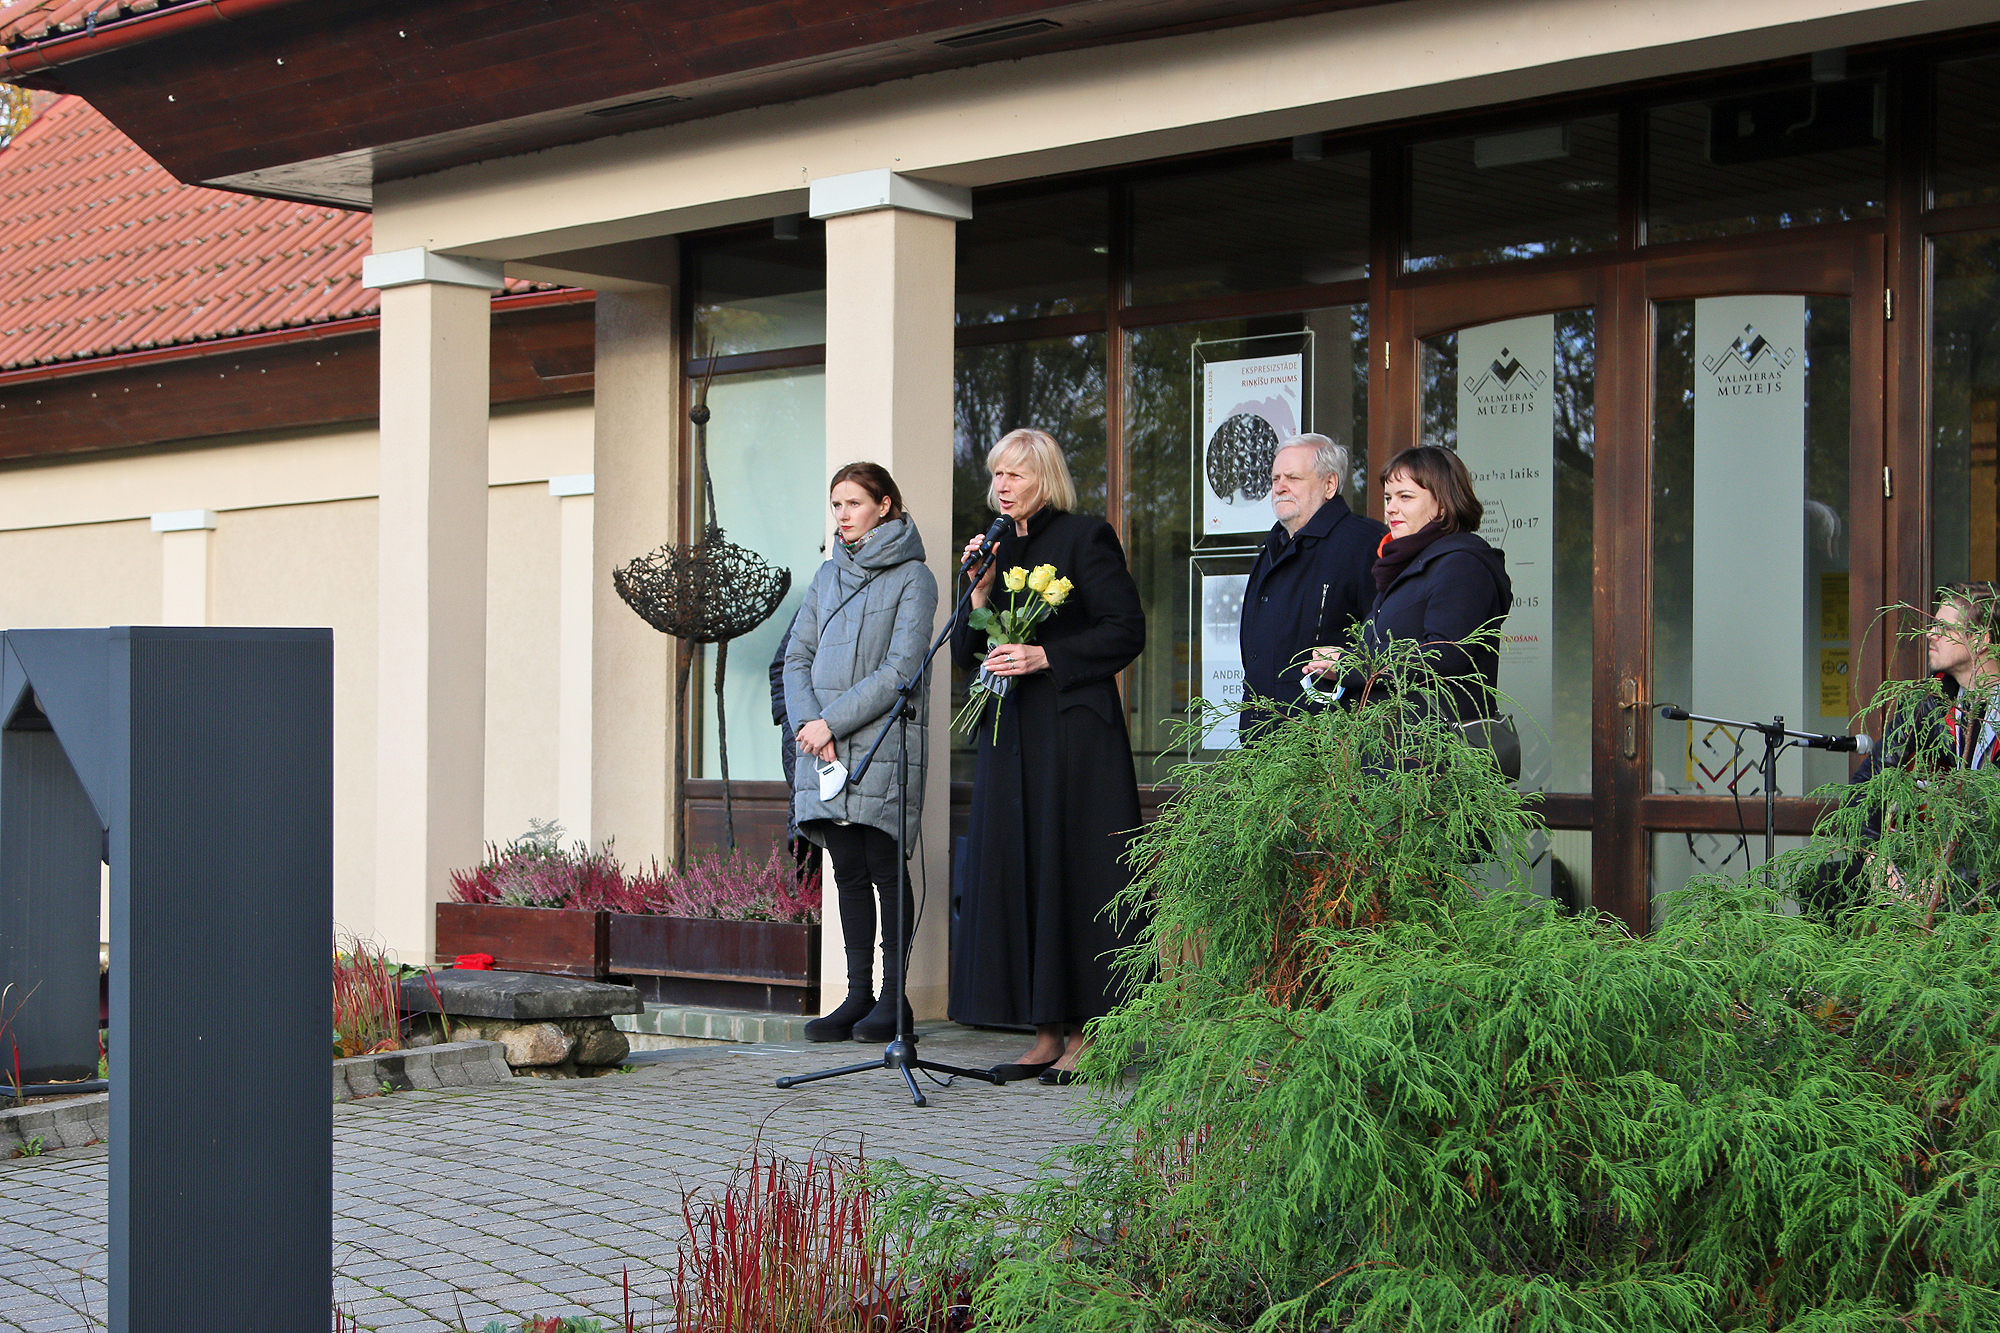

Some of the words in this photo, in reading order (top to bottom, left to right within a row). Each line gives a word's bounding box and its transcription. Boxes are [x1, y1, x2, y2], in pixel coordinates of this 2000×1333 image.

[1241, 362, 1298, 375] EKSPRESIZSTĀDE
[1270, 375, 1298, 384] PINUMS
[1717, 371, 1782, 384] VALMIERAS
[1717, 382, 1782, 397] MUZEJS
[1477, 392, 1534, 403] VALMIERAS
[1477, 402, 1534, 416] MUZEJS
[1510, 468, 1540, 479] laiks
[1512, 517, 1539, 529] 10-17
[1512, 596, 1539, 608] 10-15
[1212, 670, 1243, 680] ANDRI
[1222, 685, 1242, 694] PER
